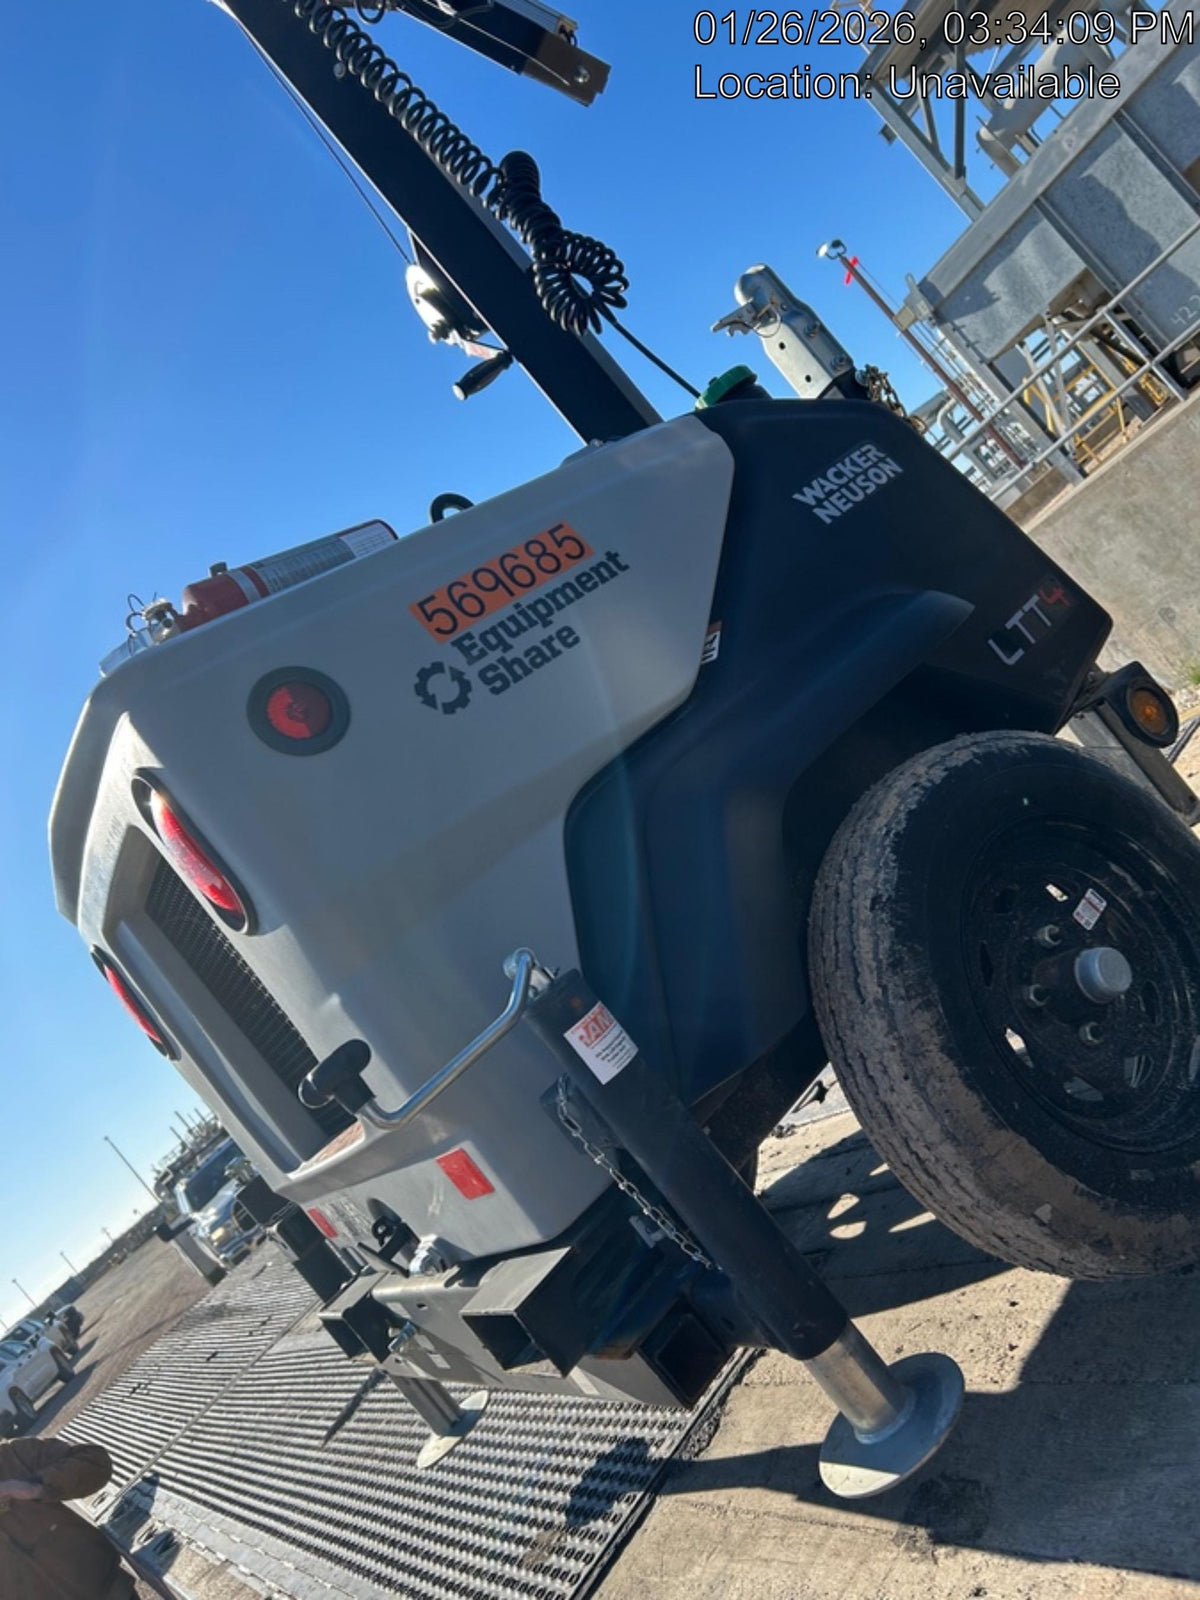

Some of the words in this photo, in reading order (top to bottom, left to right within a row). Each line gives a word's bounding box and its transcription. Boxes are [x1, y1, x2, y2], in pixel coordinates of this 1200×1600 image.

[792, 444, 887, 506] WACKER
[812, 458, 903, 525] NEUSON
[417, 523, 586, 635] 569685
[450, 550, 630, 666] Equipment
[477, 625, 581, 695] Share
